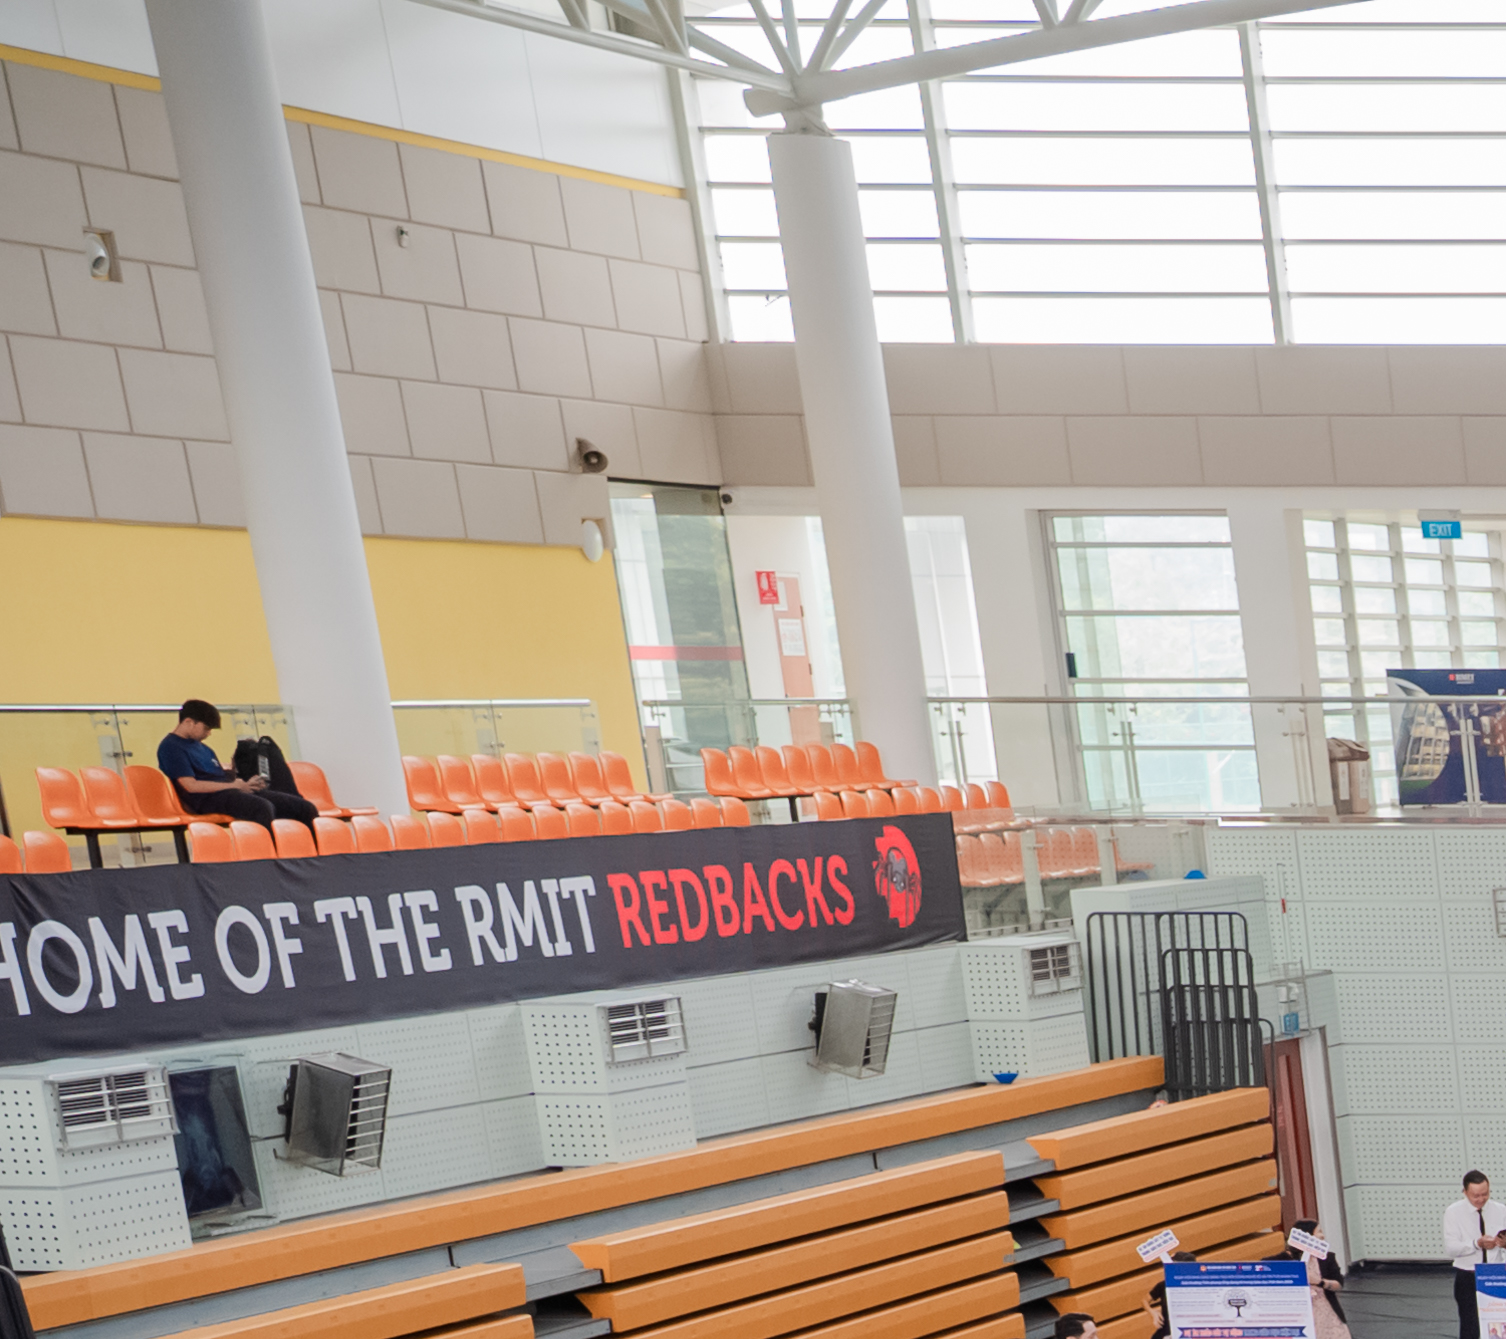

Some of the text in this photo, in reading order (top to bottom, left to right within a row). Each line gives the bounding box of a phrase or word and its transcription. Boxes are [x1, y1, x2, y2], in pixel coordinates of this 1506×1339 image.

[214, 902, 302, 994] OF
[314, 890, 452, 982] THE
[454, 875, 596, 966] RMIT
[606, 854, 856, 948] REDBACKS
